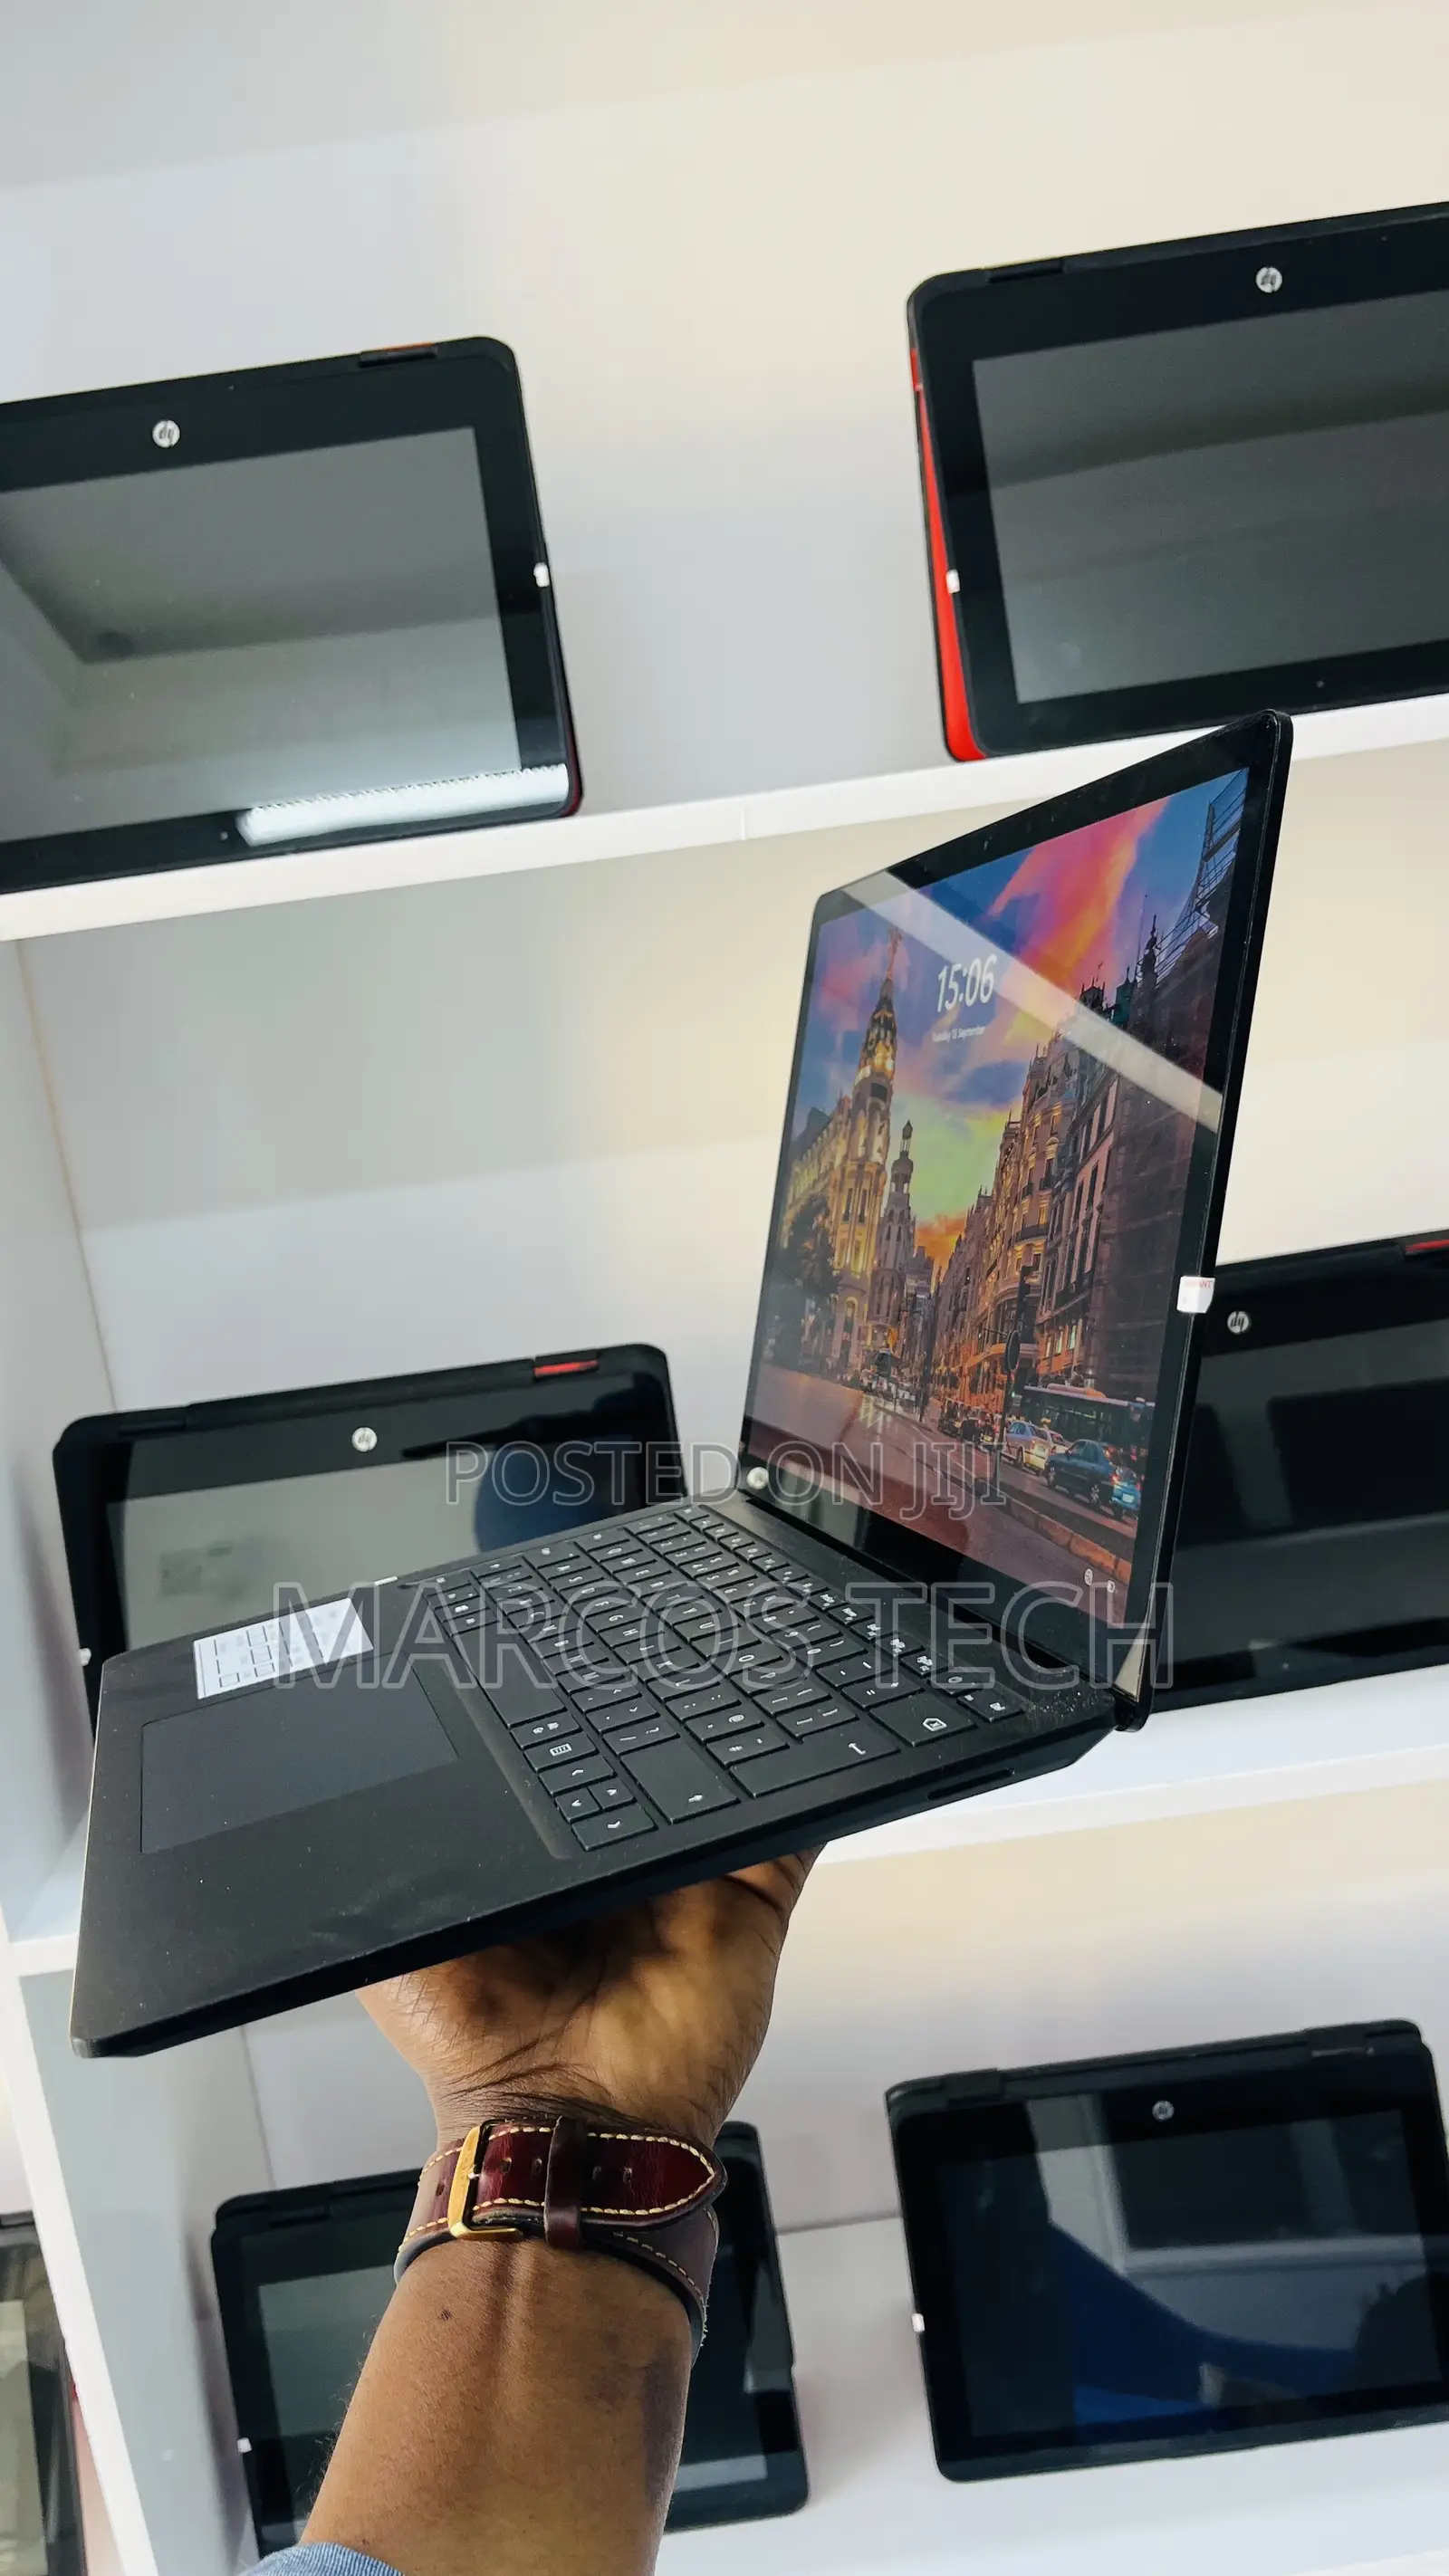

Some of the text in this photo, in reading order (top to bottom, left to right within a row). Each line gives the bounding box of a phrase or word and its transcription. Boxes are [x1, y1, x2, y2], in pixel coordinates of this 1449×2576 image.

[1255, 266, 1283, 293] hp
[152, 420, 180, 448] hp
[936, 953, 997, 1012] 15:06
[1227, 1310, 1250, 1334] hp
